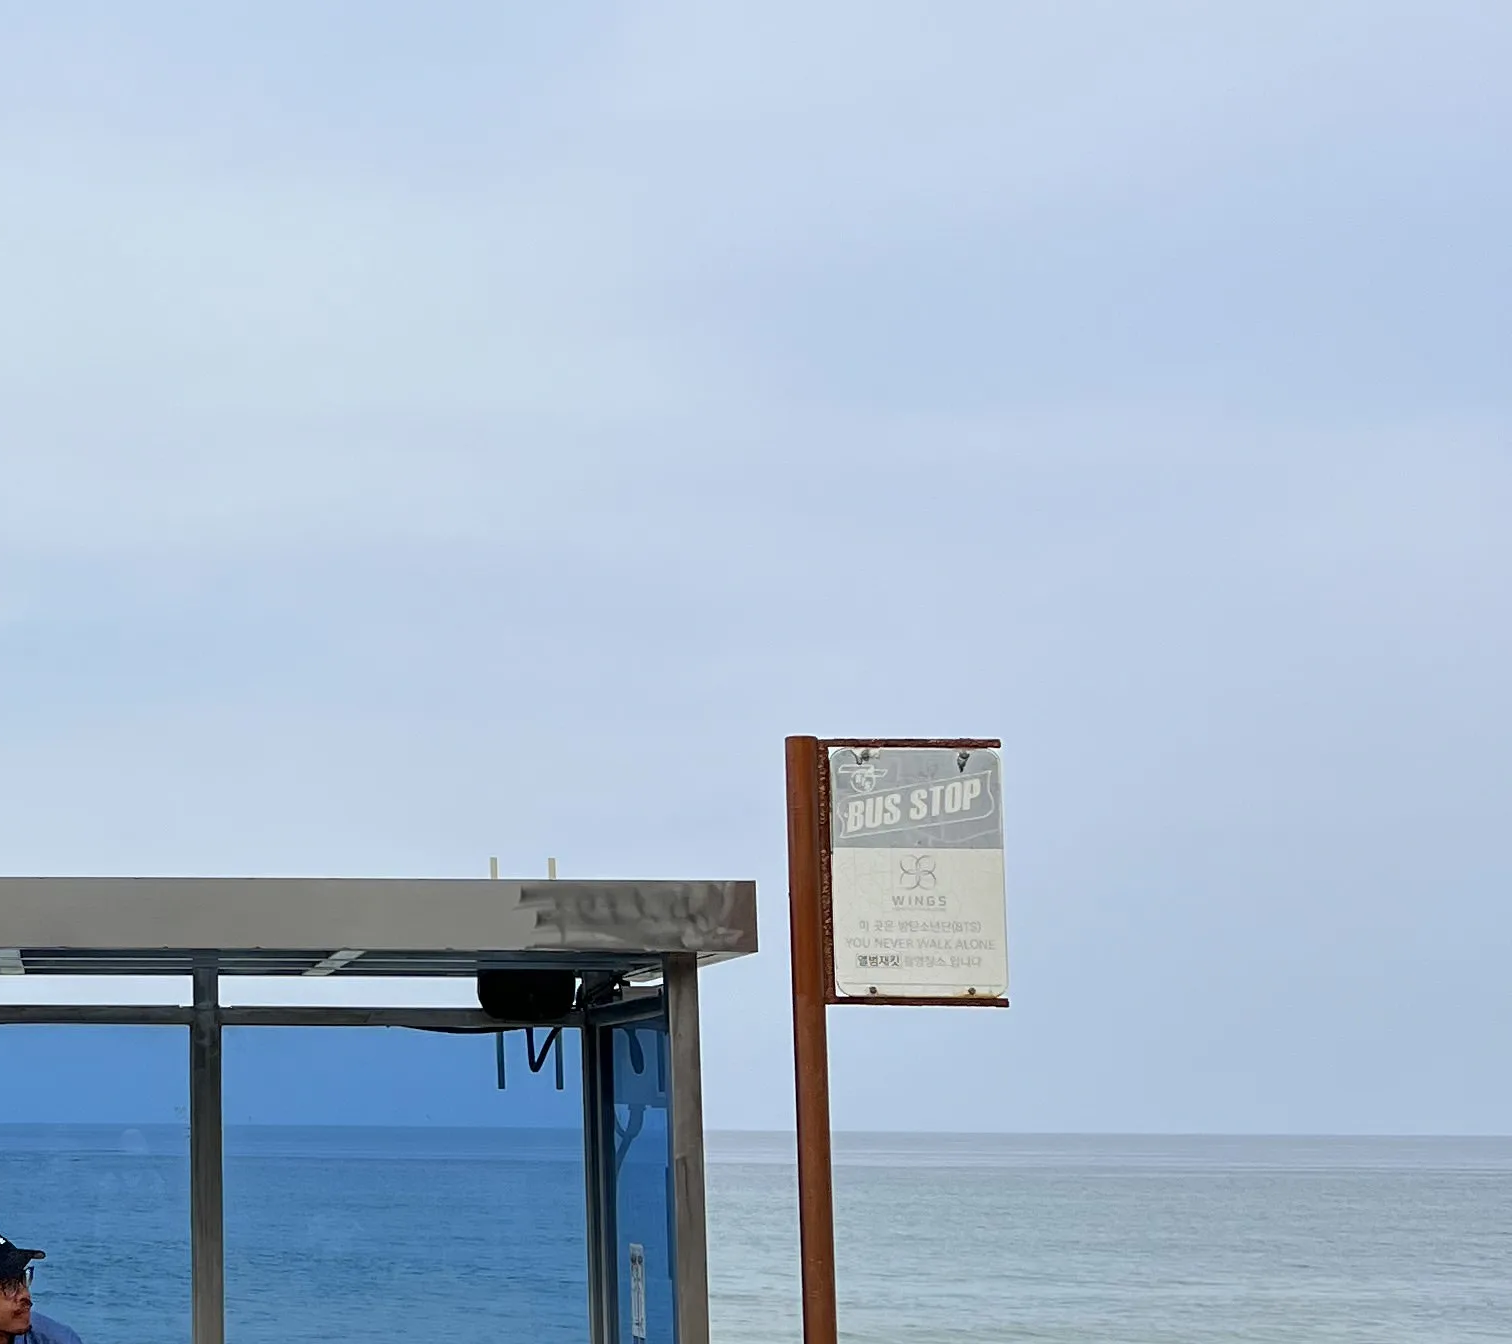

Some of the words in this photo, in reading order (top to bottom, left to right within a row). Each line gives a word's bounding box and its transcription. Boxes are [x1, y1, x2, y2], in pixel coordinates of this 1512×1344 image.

[847, 794, 901, 833] BUS
[909, 778, 981, 821] STOP
[892, 895, 947, 907] WINGS
[846, 937, 871, 949] YOU
[875, 937, 914, 949] NEVER
[918, 938, 952, 950] WALK
[955, 939, 997, 951] ALONE
